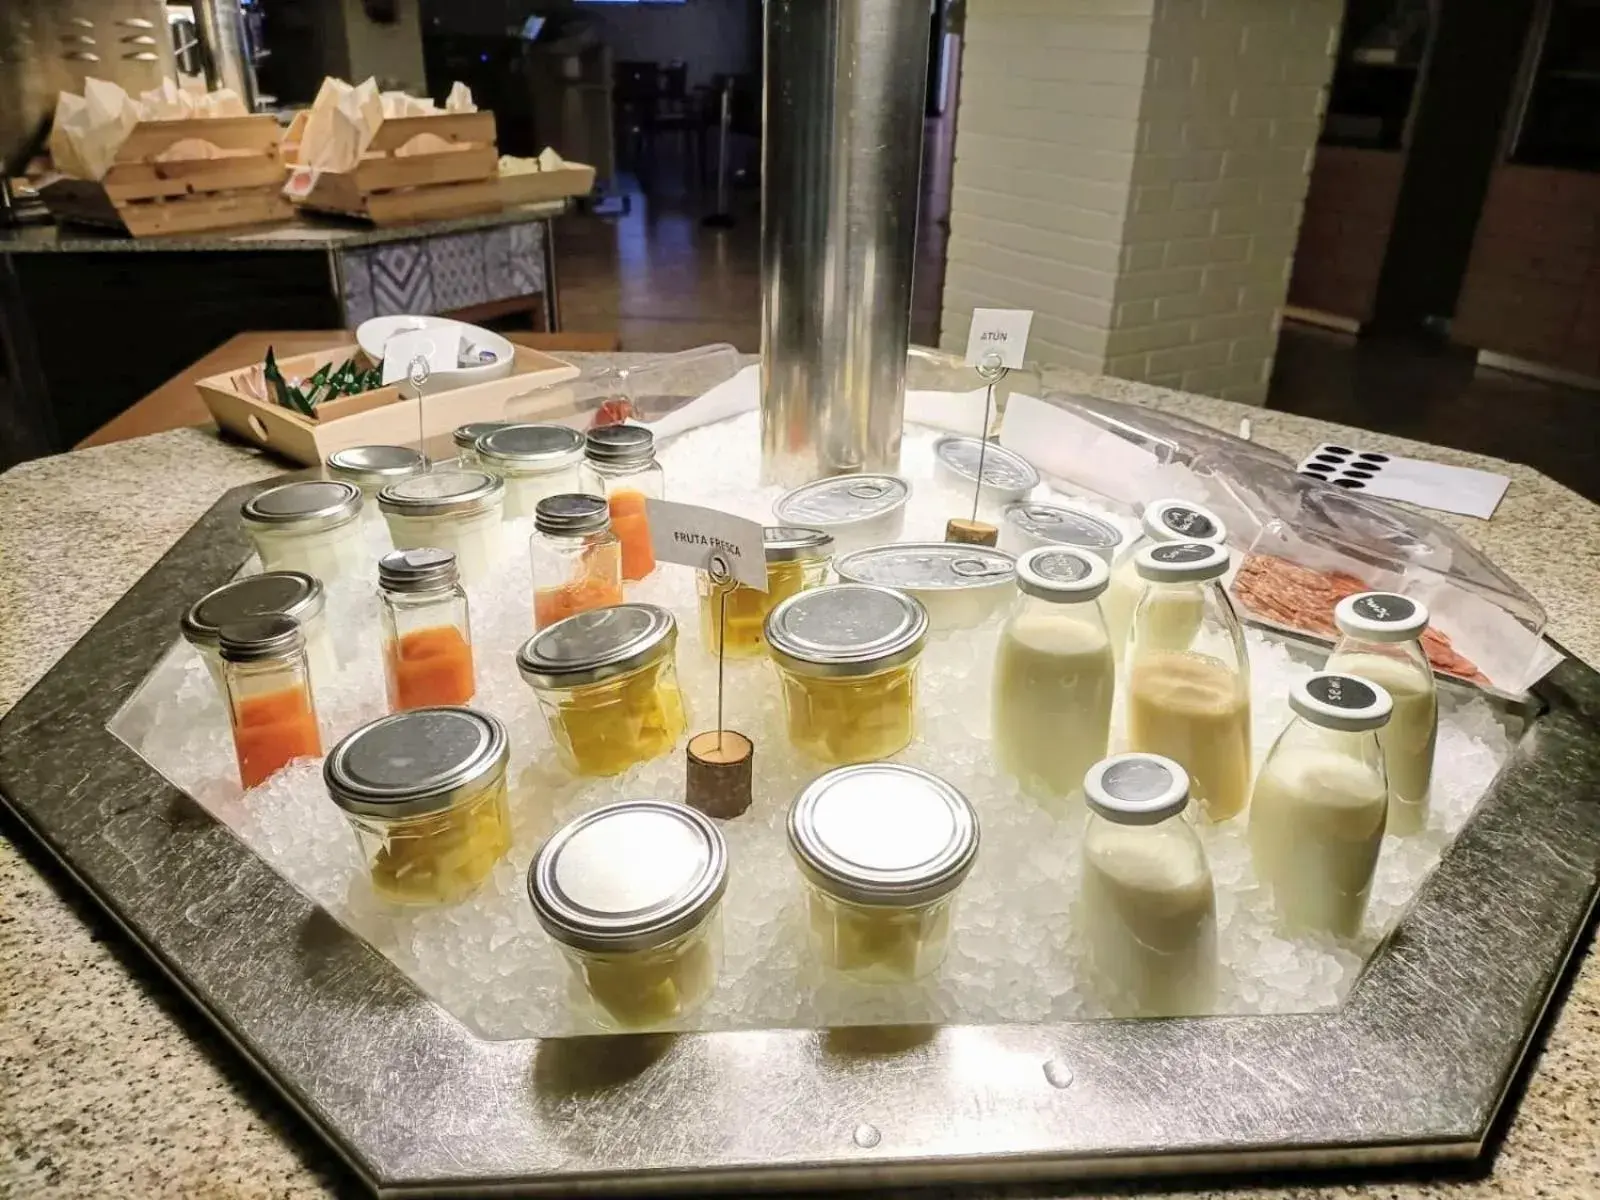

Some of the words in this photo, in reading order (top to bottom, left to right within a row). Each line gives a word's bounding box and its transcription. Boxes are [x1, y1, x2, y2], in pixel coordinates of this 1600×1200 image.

[980, 329, 1008, 341] ATÚN
[674, 531, 708, 546] FRUTA
[709, 537, 742, 558] FRESCA
